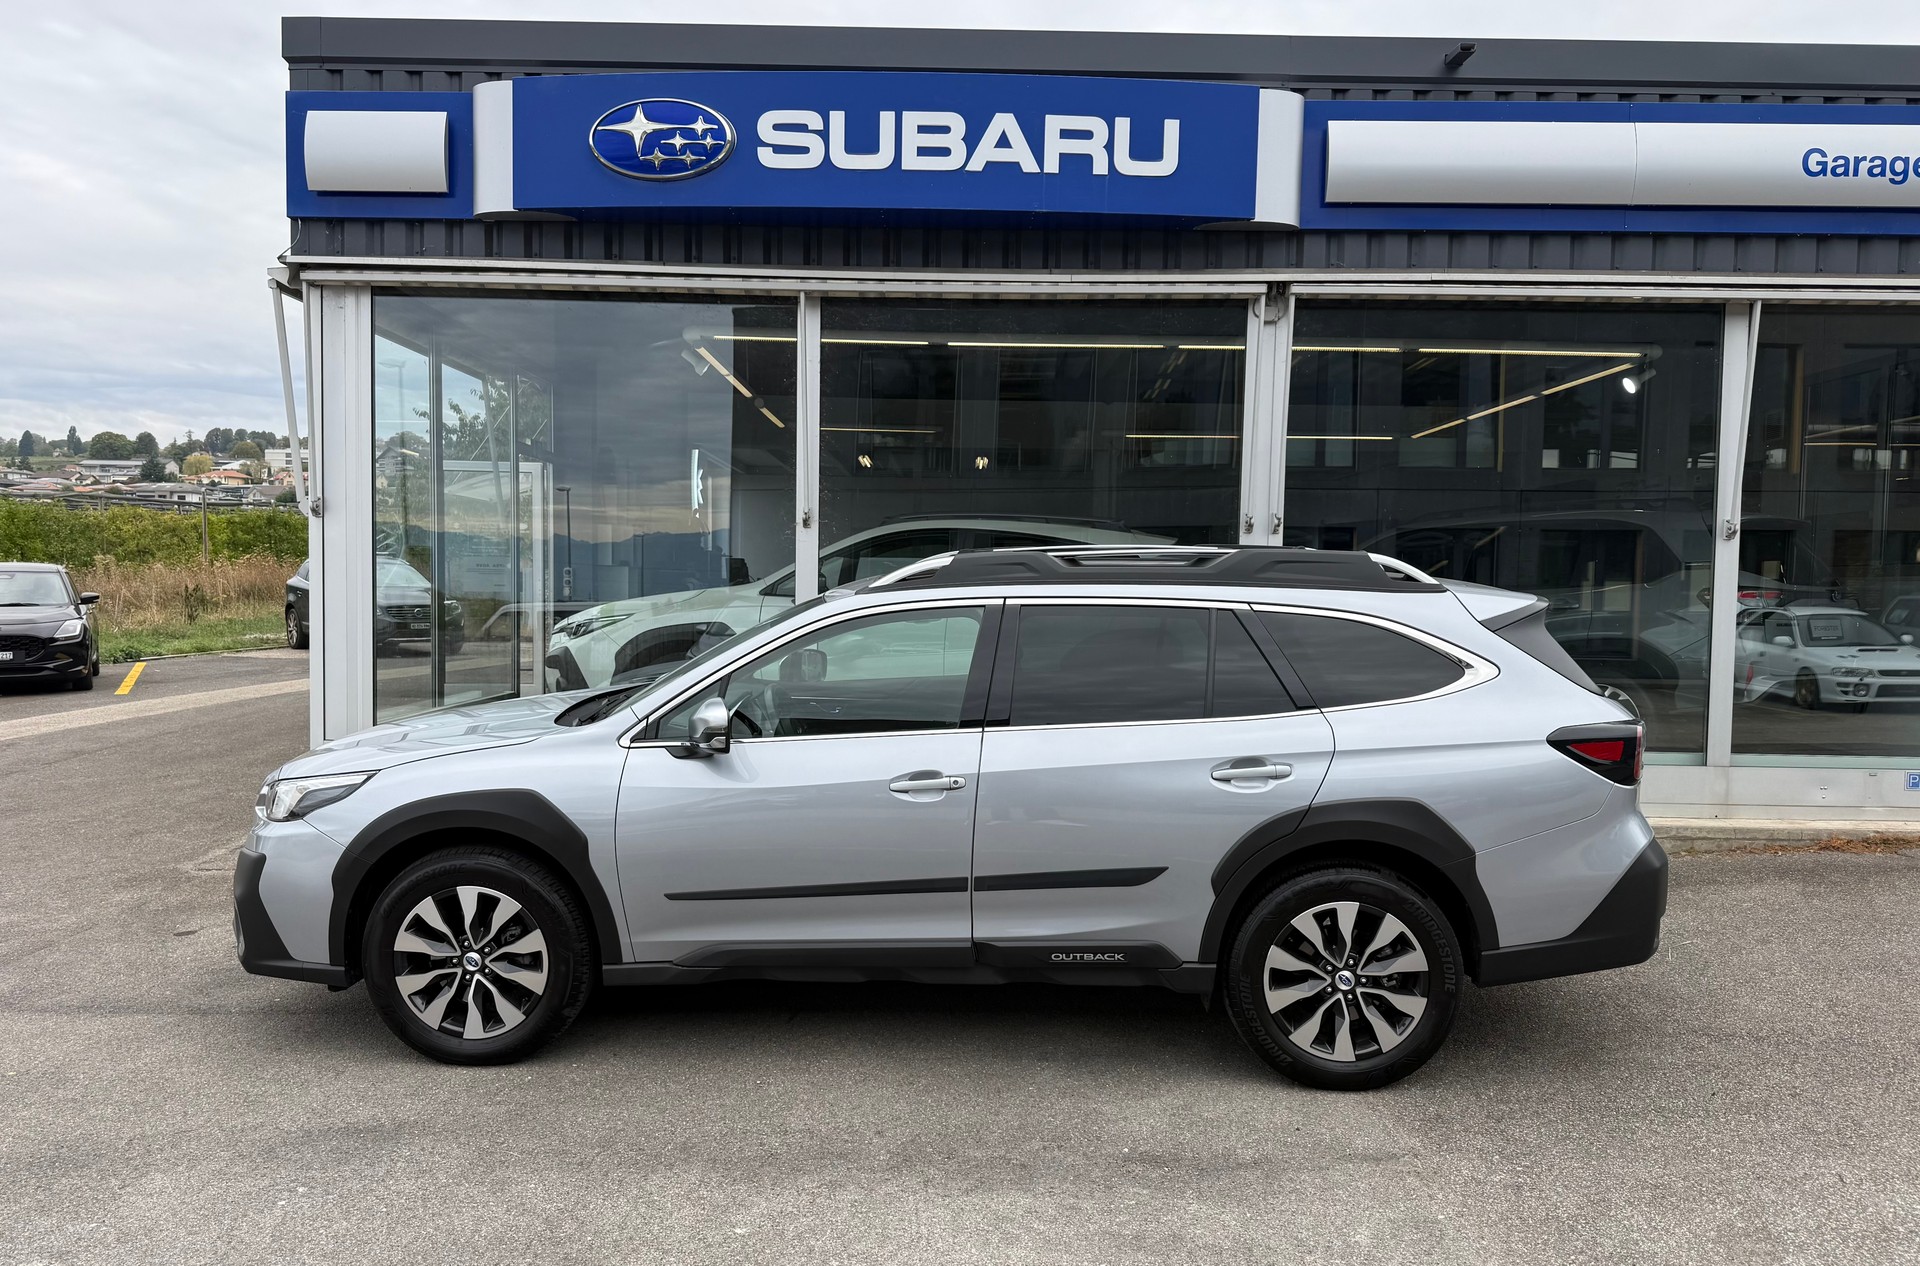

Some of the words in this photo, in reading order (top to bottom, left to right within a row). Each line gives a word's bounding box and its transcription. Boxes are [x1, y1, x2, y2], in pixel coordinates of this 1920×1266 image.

[756, 109, 1180, 178] SUBARU
[1909, 775, 1919, 787] P
[383, 863, 468, 918] ESTONE
[1051, 953, 1125, 961] OUTBACK
[1407, 899, 1456, 993] BRIDGESTONE
[1239, 975, 1294, 1066] BRIDGESTONE
